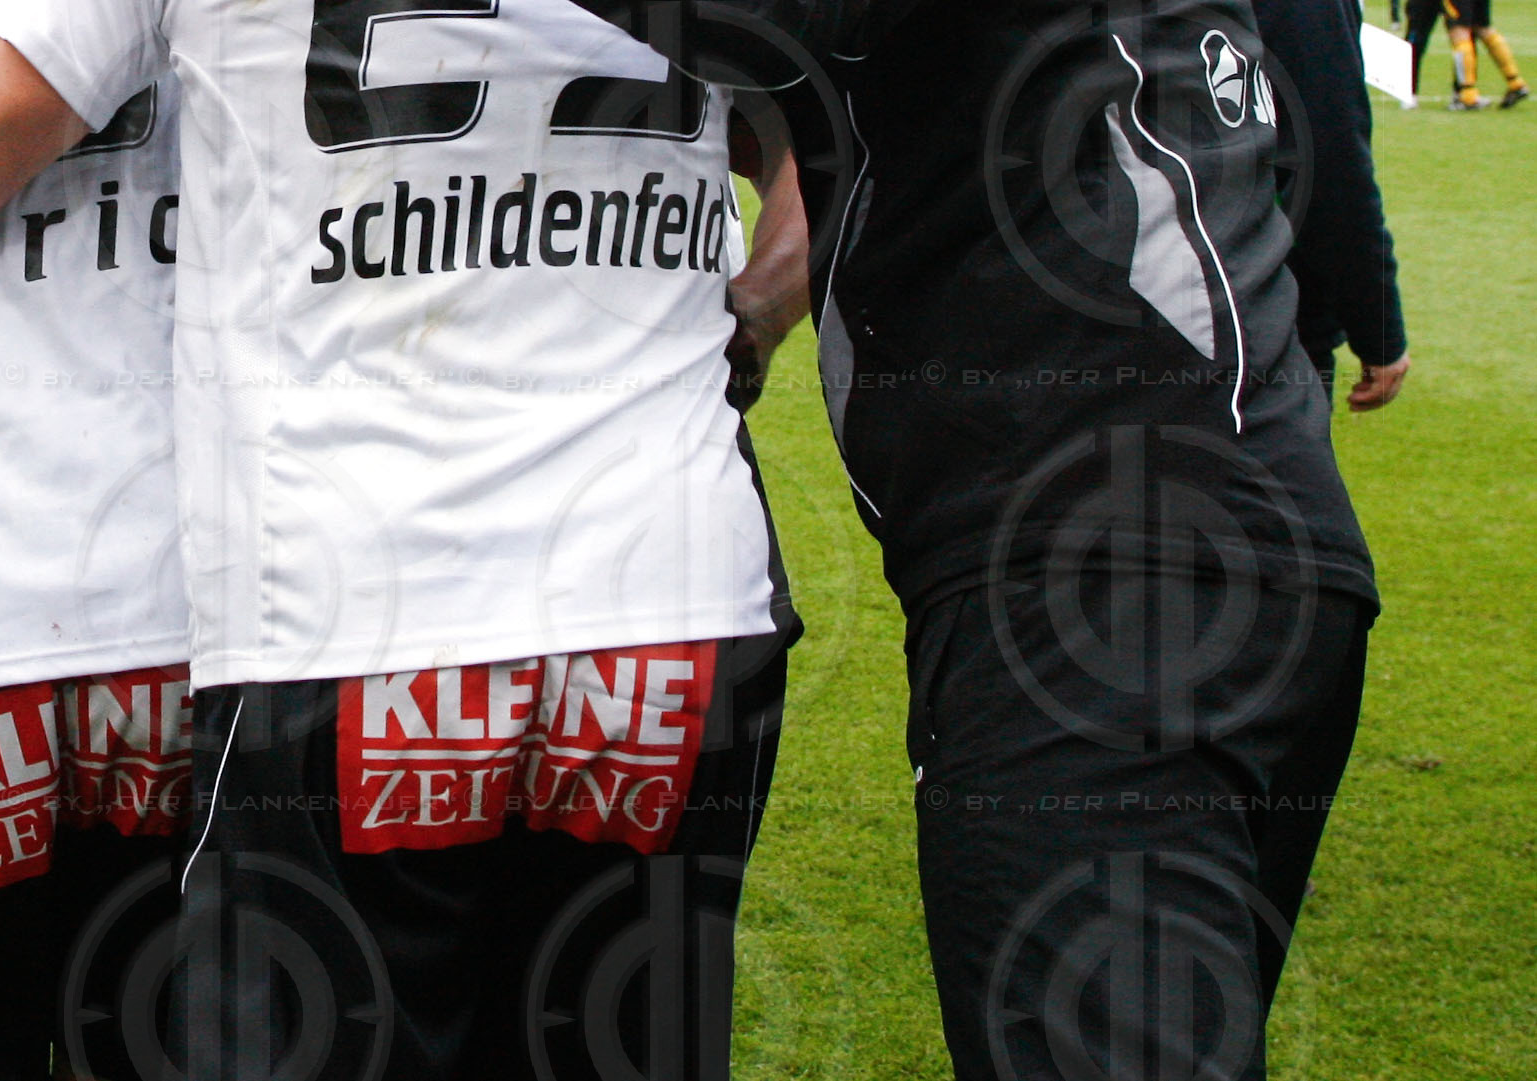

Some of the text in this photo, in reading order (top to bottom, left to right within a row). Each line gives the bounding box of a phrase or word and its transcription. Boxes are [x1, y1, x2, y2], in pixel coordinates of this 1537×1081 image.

[311, 172, 724, 285] schildenfeld
[361, 654, 695, 746] KLEINE
[360, 750, 674, 833] ZEITUNG
